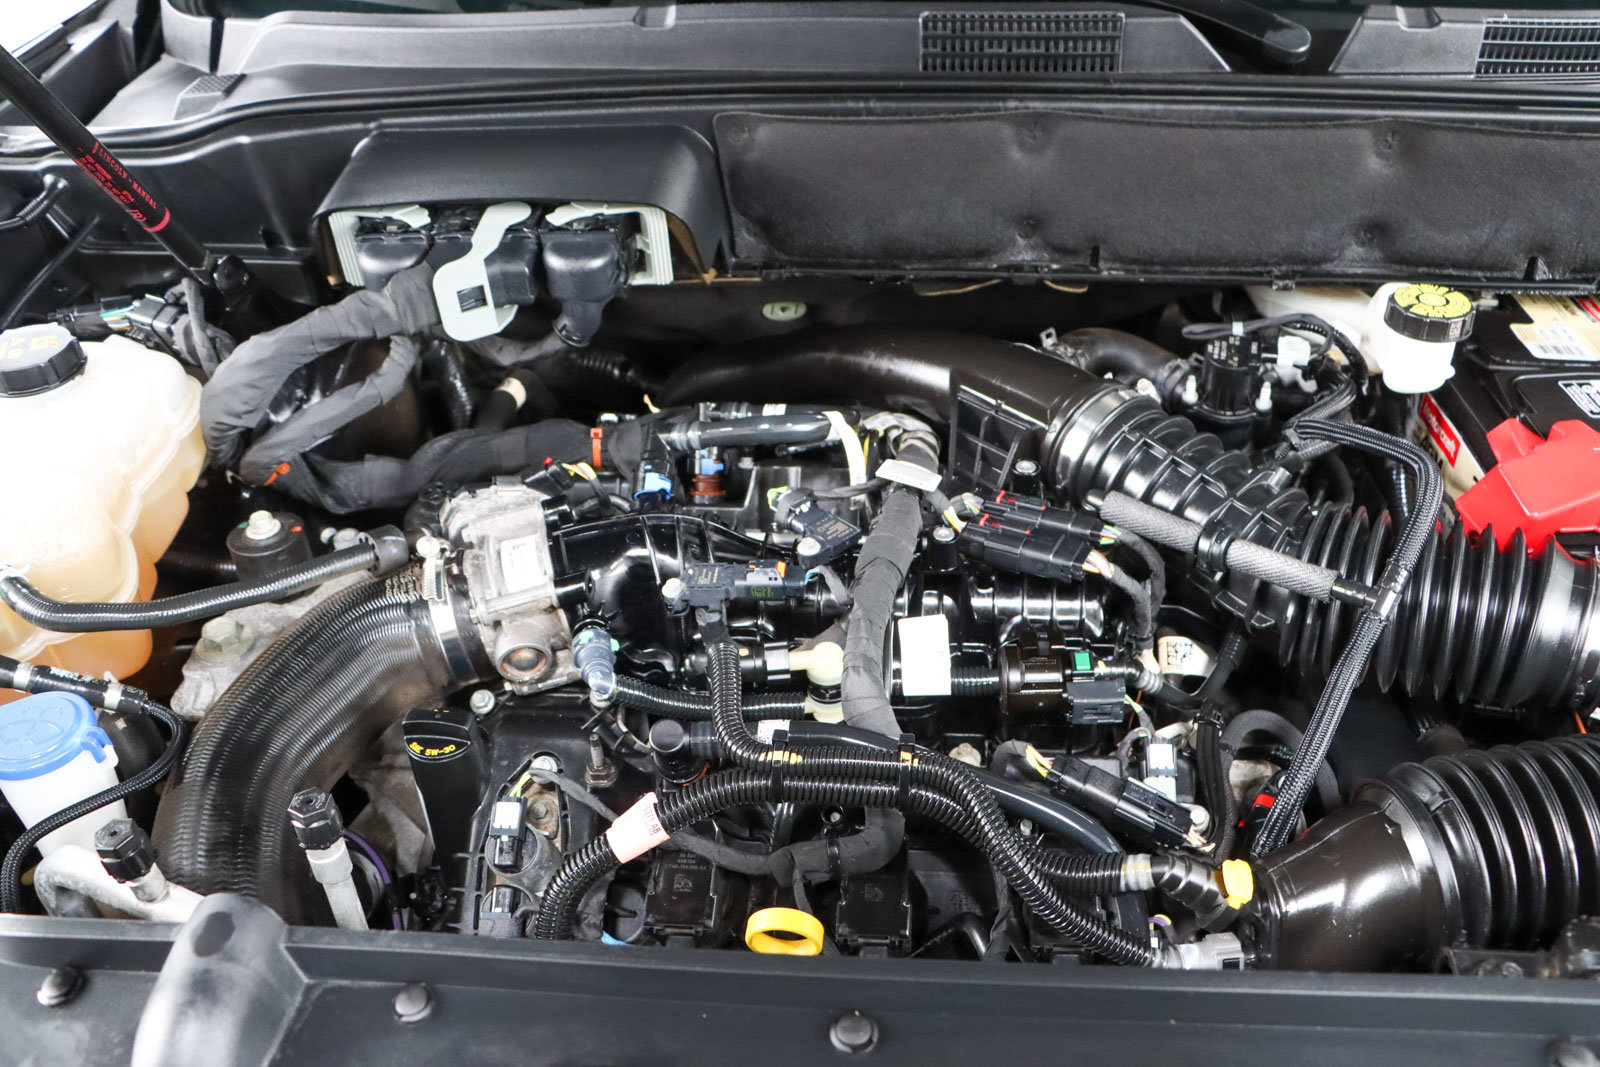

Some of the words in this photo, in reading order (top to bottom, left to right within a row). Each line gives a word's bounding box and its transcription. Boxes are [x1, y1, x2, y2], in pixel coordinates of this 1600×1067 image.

[98, 148, 128, 179] LINCOLN
[132, 181, 157, 209] MANUAL
[409, 741, 424, 754] SAE
[425, 744, 456, 756] 5W-30
